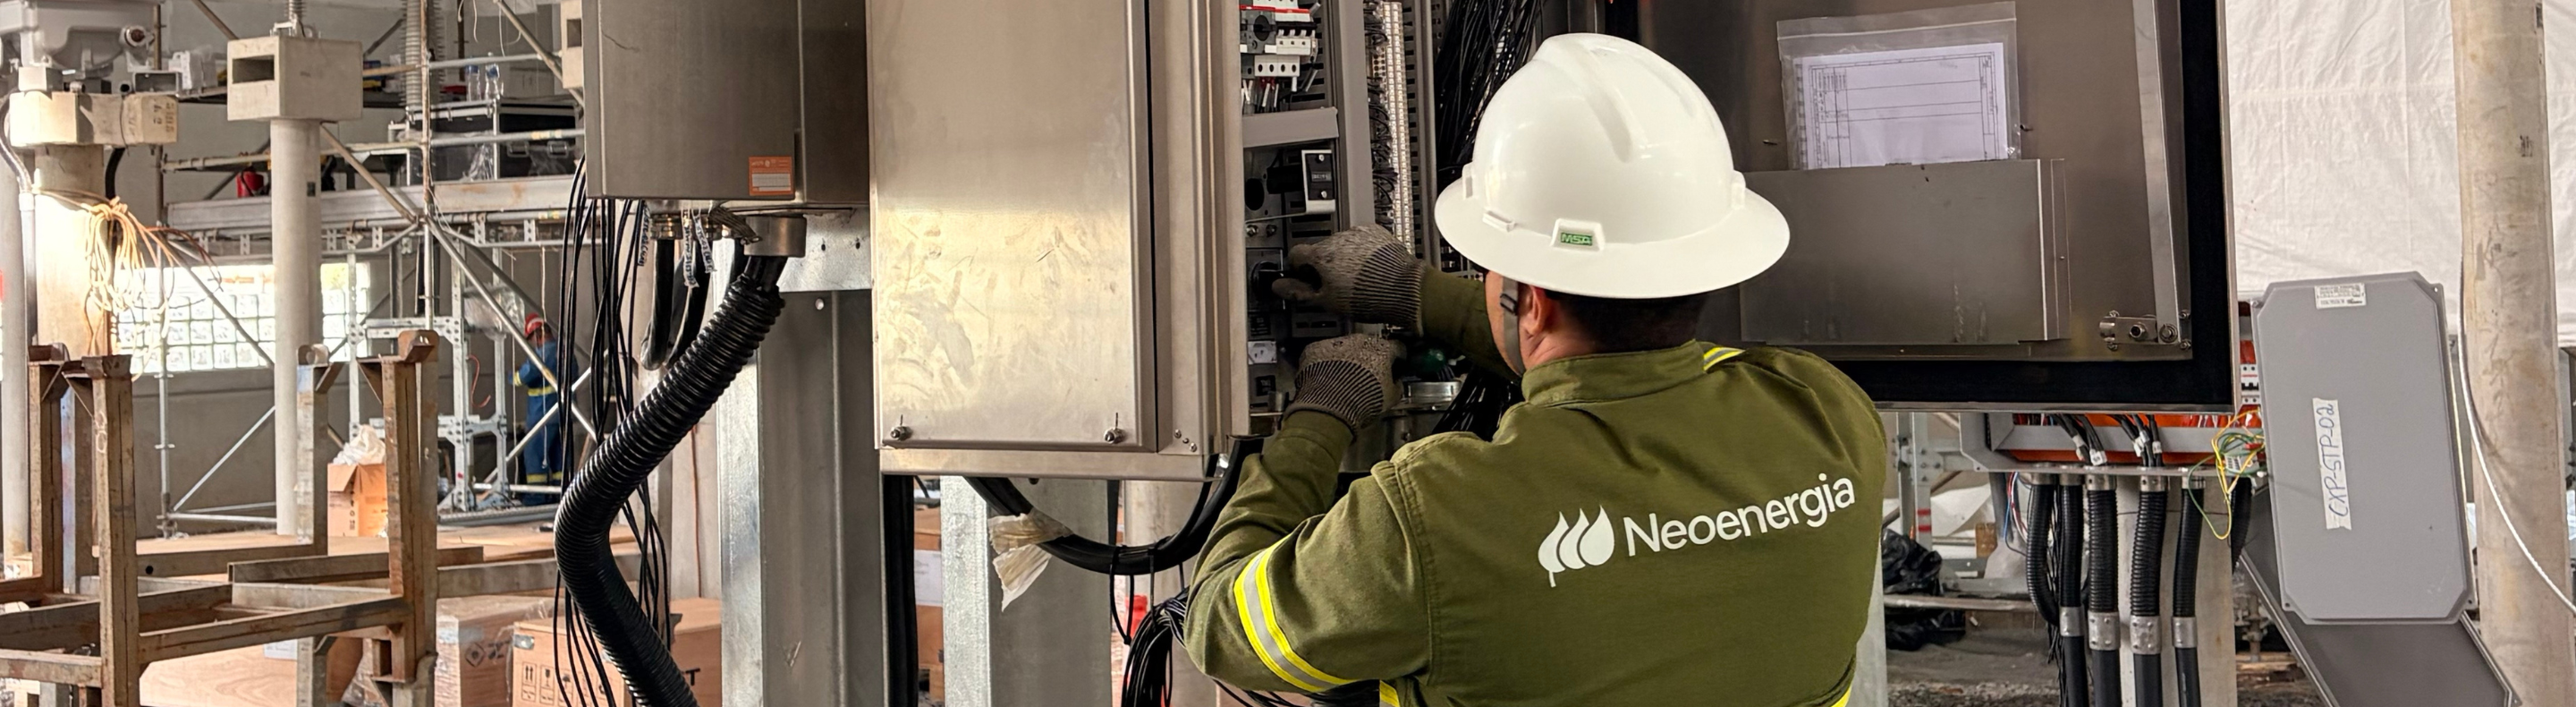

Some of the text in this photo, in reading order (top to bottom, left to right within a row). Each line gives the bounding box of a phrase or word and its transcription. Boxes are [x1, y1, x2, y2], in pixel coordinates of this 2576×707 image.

[1562, 233, 1592, 246] MSA
[2317, 404, 2348, 517] CXP-STP-02
[1623, 473, 1856, 557] Neoenergia
